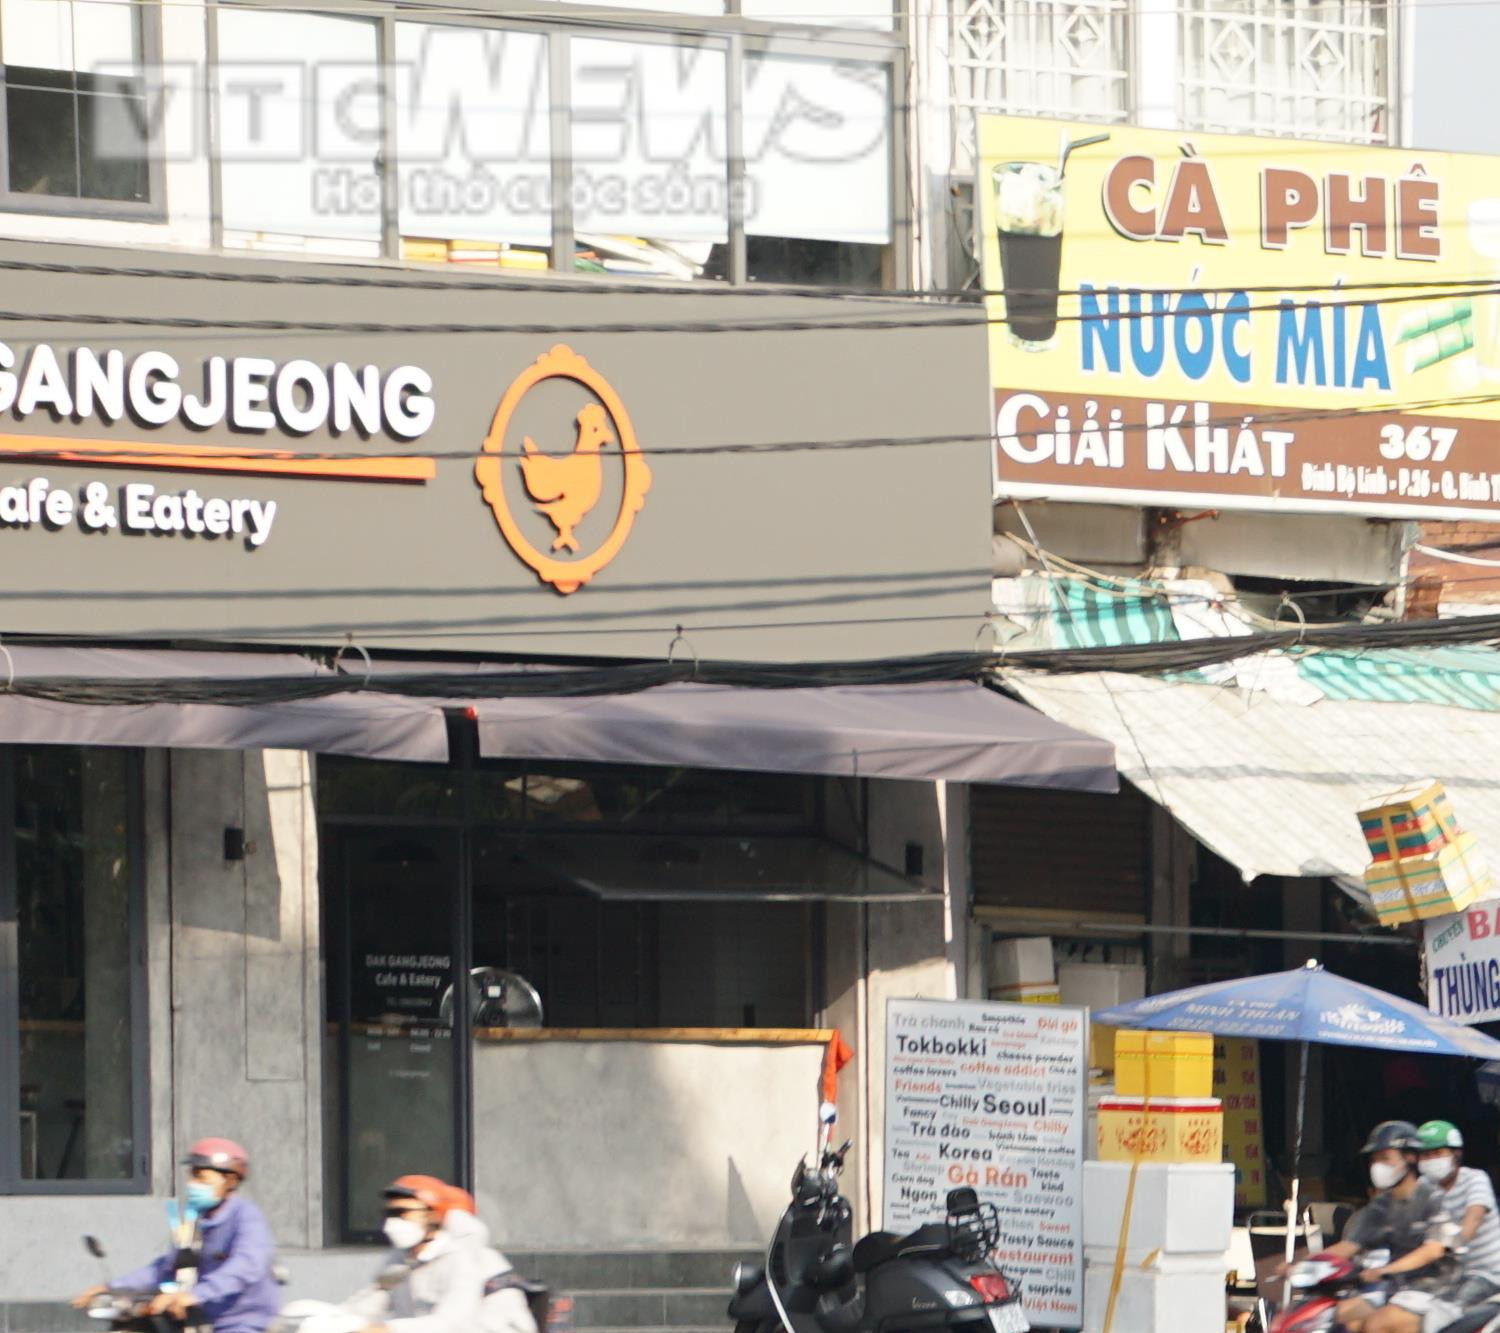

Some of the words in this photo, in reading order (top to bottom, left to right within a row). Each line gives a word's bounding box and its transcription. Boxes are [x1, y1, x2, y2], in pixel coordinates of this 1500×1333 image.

[1102, 142, 1229, 246] CÀ
[1260, 163, 1441, 261] PHÊ
[1078, 267, 1251, 383] NƯỚC
[1276, 278, 1391, 390] MÍA
[1379, 424, 1459, 462] 367
[0, 477, 74, 527] afe
[83, 481, 117, 529] &
[126, 483, 277, 546] Eatery
[1433, 952, 1500, 1017] THÙNG
[896, 1034, 987, 1057] Tokbokki
[894, 1080, 942, 1094] Friends
[940, 1094, 980, 1113] Chilly
[983, 1093, 1046, 1117] Seoul
[910, 1122, 937, 1137] Trà
[940, 1122, 971, 1138] đào
[939, 1143, 993, 1161] Korea
[946, 1162, 979, 1186] Gà
[984, 1165, 1028, 1189] Rán
[901, 1187, 937, 1201] Ngon
[1037, 1234, 1075, 1248] Sauce
